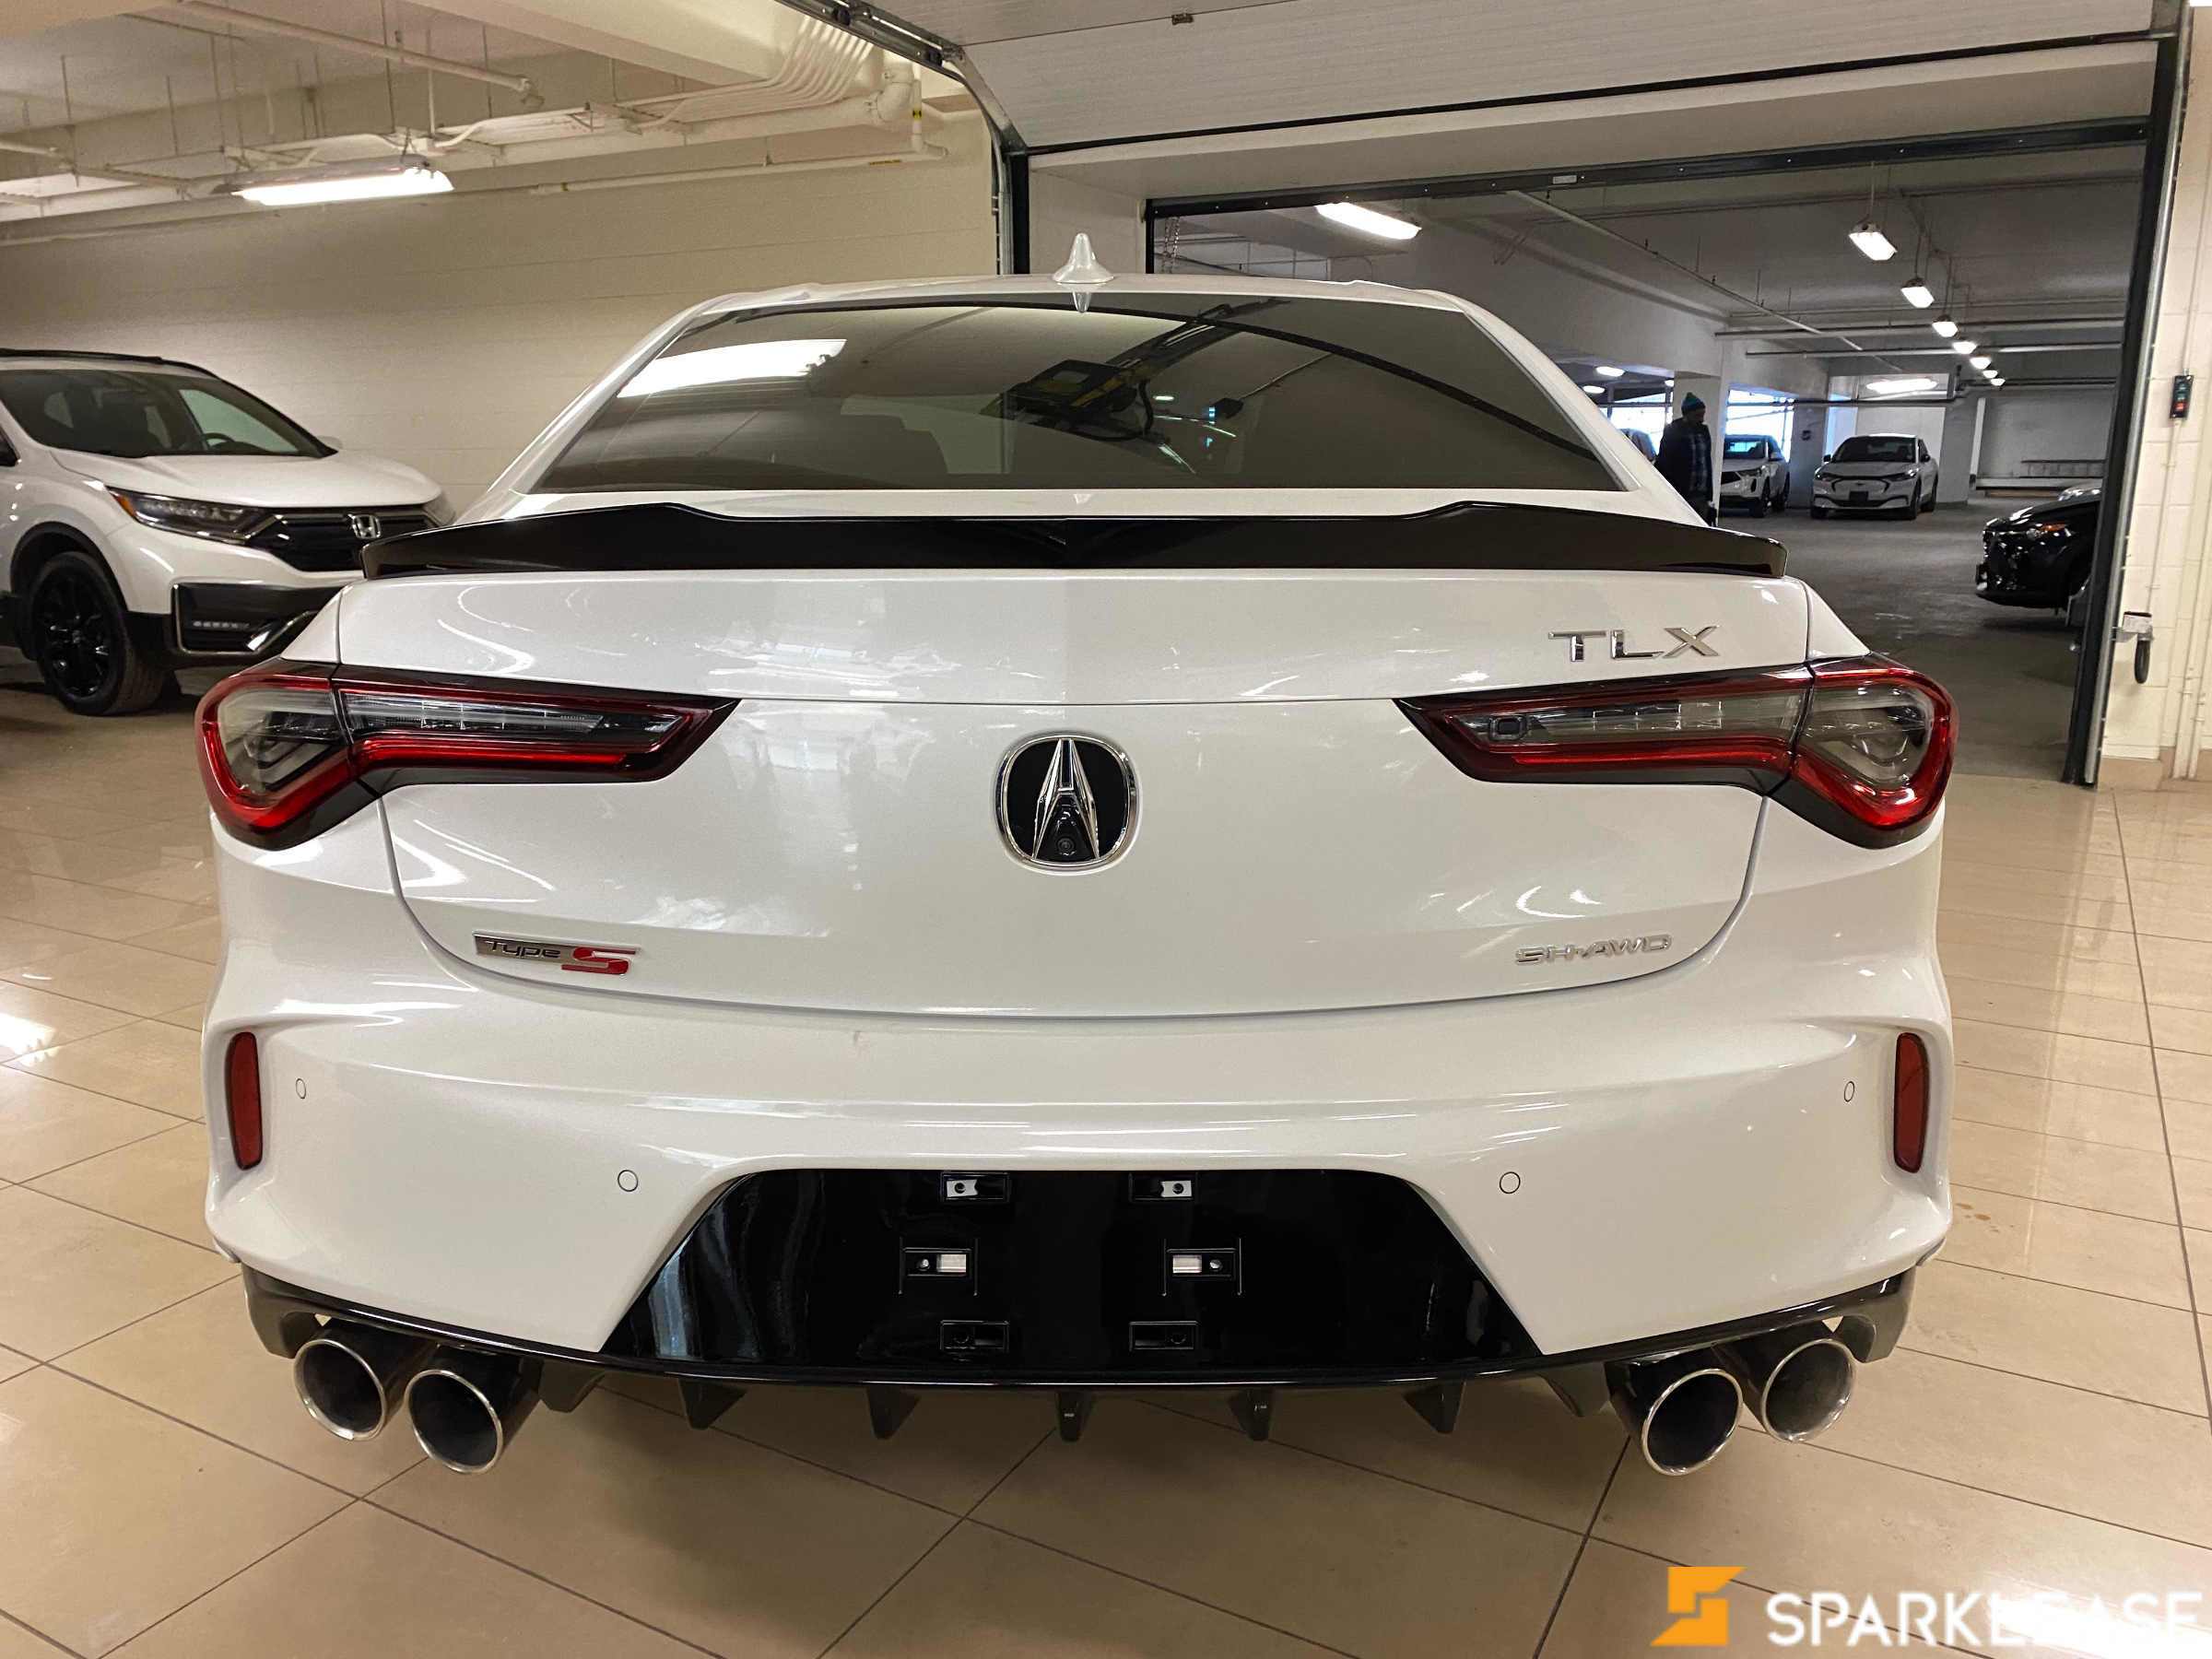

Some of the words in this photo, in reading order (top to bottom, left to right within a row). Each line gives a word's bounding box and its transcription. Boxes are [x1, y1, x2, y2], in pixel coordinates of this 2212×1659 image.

[1548, 626, 1719, 662] TLX
[486, 939, 561, 959] Type
[560, 946, 636, 975] S
[1516, 934, 1672, 964] SH-AWD
